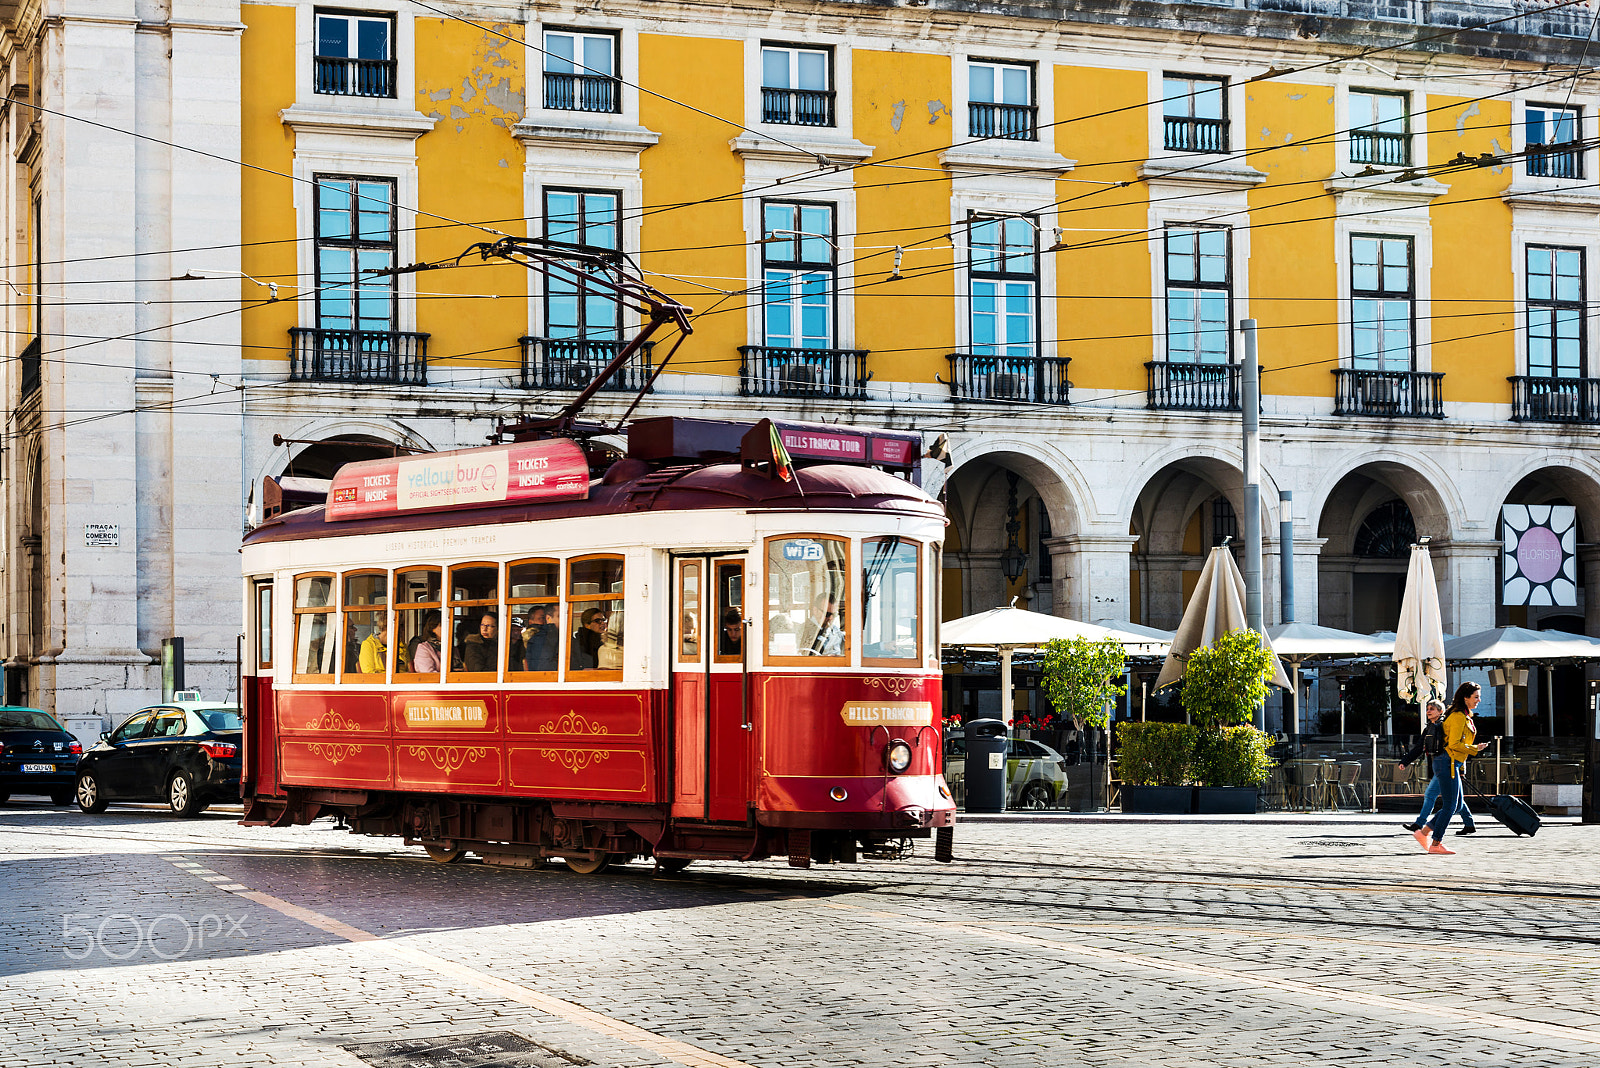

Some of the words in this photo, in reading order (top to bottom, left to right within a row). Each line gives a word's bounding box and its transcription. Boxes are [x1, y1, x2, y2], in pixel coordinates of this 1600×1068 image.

[785, 435, 808, 449] HILLS
[808, 437, 841, 451] TRAMCAR
[841, 439, 861, 453] TOUR
[516, 456, 549, 471] TICKETS
[363, 474, 391, 488] TICKETS
[408, 466, 454, 488] yellow
[457, 463, 480, 482] bus
[518, 474, 546, 487] INSIDE
[364, 489, 388, 503] INSIDE
[409, 489, 429, 499] OFFICIAL
[430, 486, 460, 497] SIGHTSEEING
[461, 485, 478, 494] TOURS
[385, 541, 405, 552] LISBON
[408, 538, 439, 550] HISTORICAL
[443, 536, 468, 547] PREMIUM
[471, 533, 497, 544] TRAMCAR
[1520, 549, 1561, 560] FLORISTA
[408, 707, 430, 721] HILLS
[431, 706, 463, 721] TRAMCAR
[463, 706, 483, 721] TOUR
[848, 707, 880, 721] HILLS
[880, 707, 915, 721] TRAMCAR
